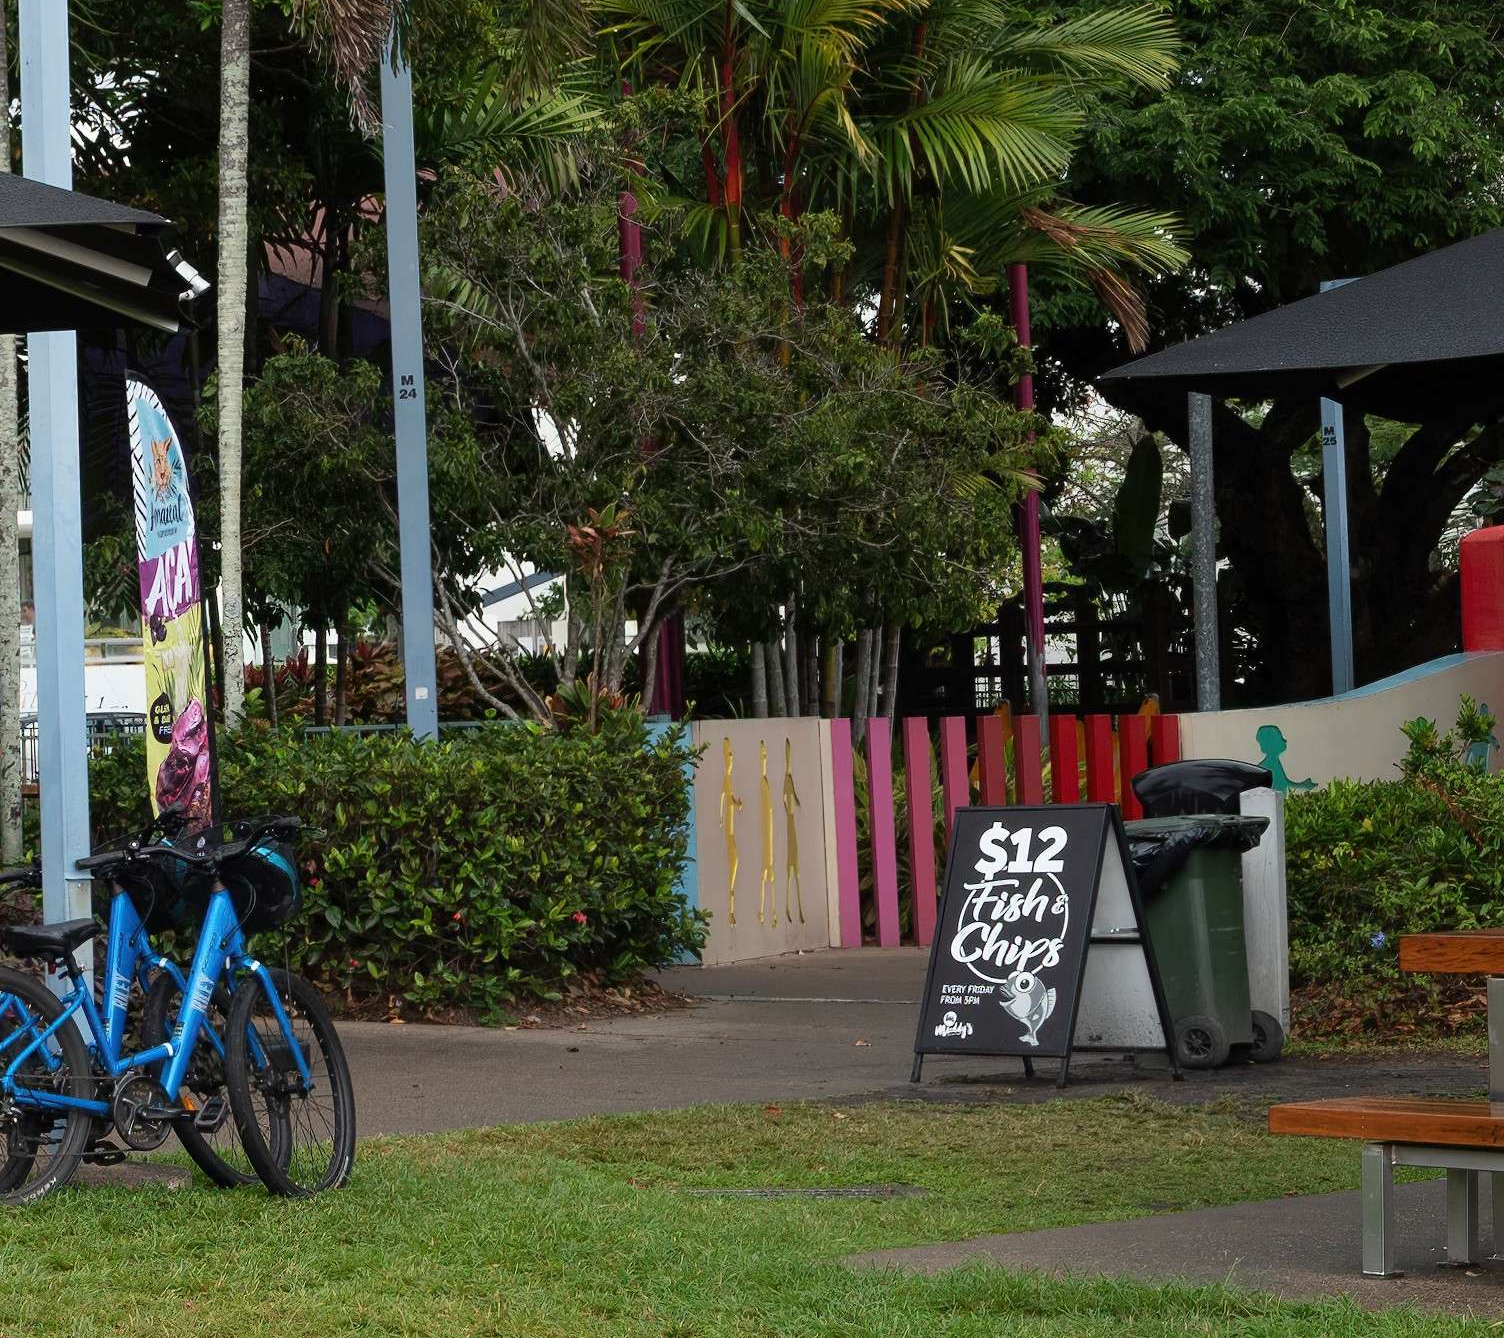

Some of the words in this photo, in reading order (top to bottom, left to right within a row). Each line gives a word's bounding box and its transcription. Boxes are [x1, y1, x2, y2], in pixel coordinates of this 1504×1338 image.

[974, 821, 1068, 880] $12
[963, 878, 1048, 923] Fish
[1051, 893, 1069, 915] &
[950, 921, 1065, 972] Chips
[940, 995, 963, 1004] FROM
[942, 984, 966, 994] EVERY
[968, 984, 995, 994] FRIDAY
